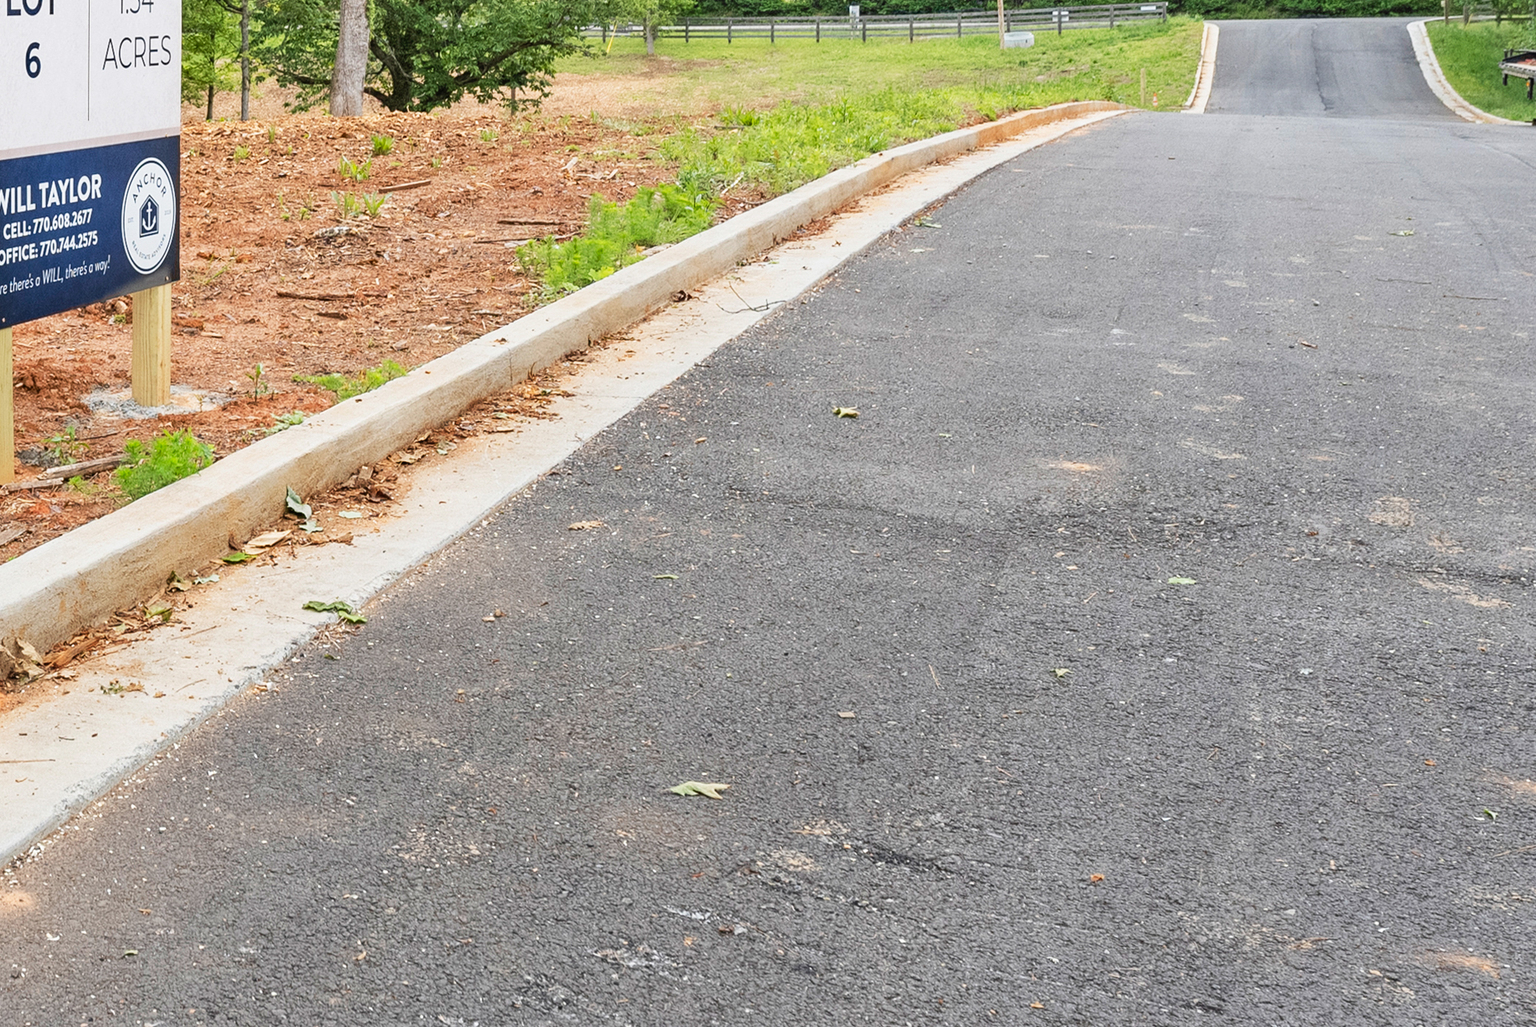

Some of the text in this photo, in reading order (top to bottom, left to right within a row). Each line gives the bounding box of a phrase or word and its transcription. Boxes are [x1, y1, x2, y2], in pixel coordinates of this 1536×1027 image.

[25, 41, 42, 79] 6
[102, 35, 173, 71] ACRES
[38, 173, 102, 209] TAYLOR
[132, 172, 168, 204] ANCHOR
[3, 208, 93, 240] CELL: 770.608.2677
[39, 230, 98, 257] 770.744.2575
[9, 273, 34, 293] there's
[35, 276, 41, 287] a
[42, 266, 64, 283] WILL,
[65, 260, 88, 280] there's
[88, 264, 94, 274] a
[95, 254, 111, 275] way!
